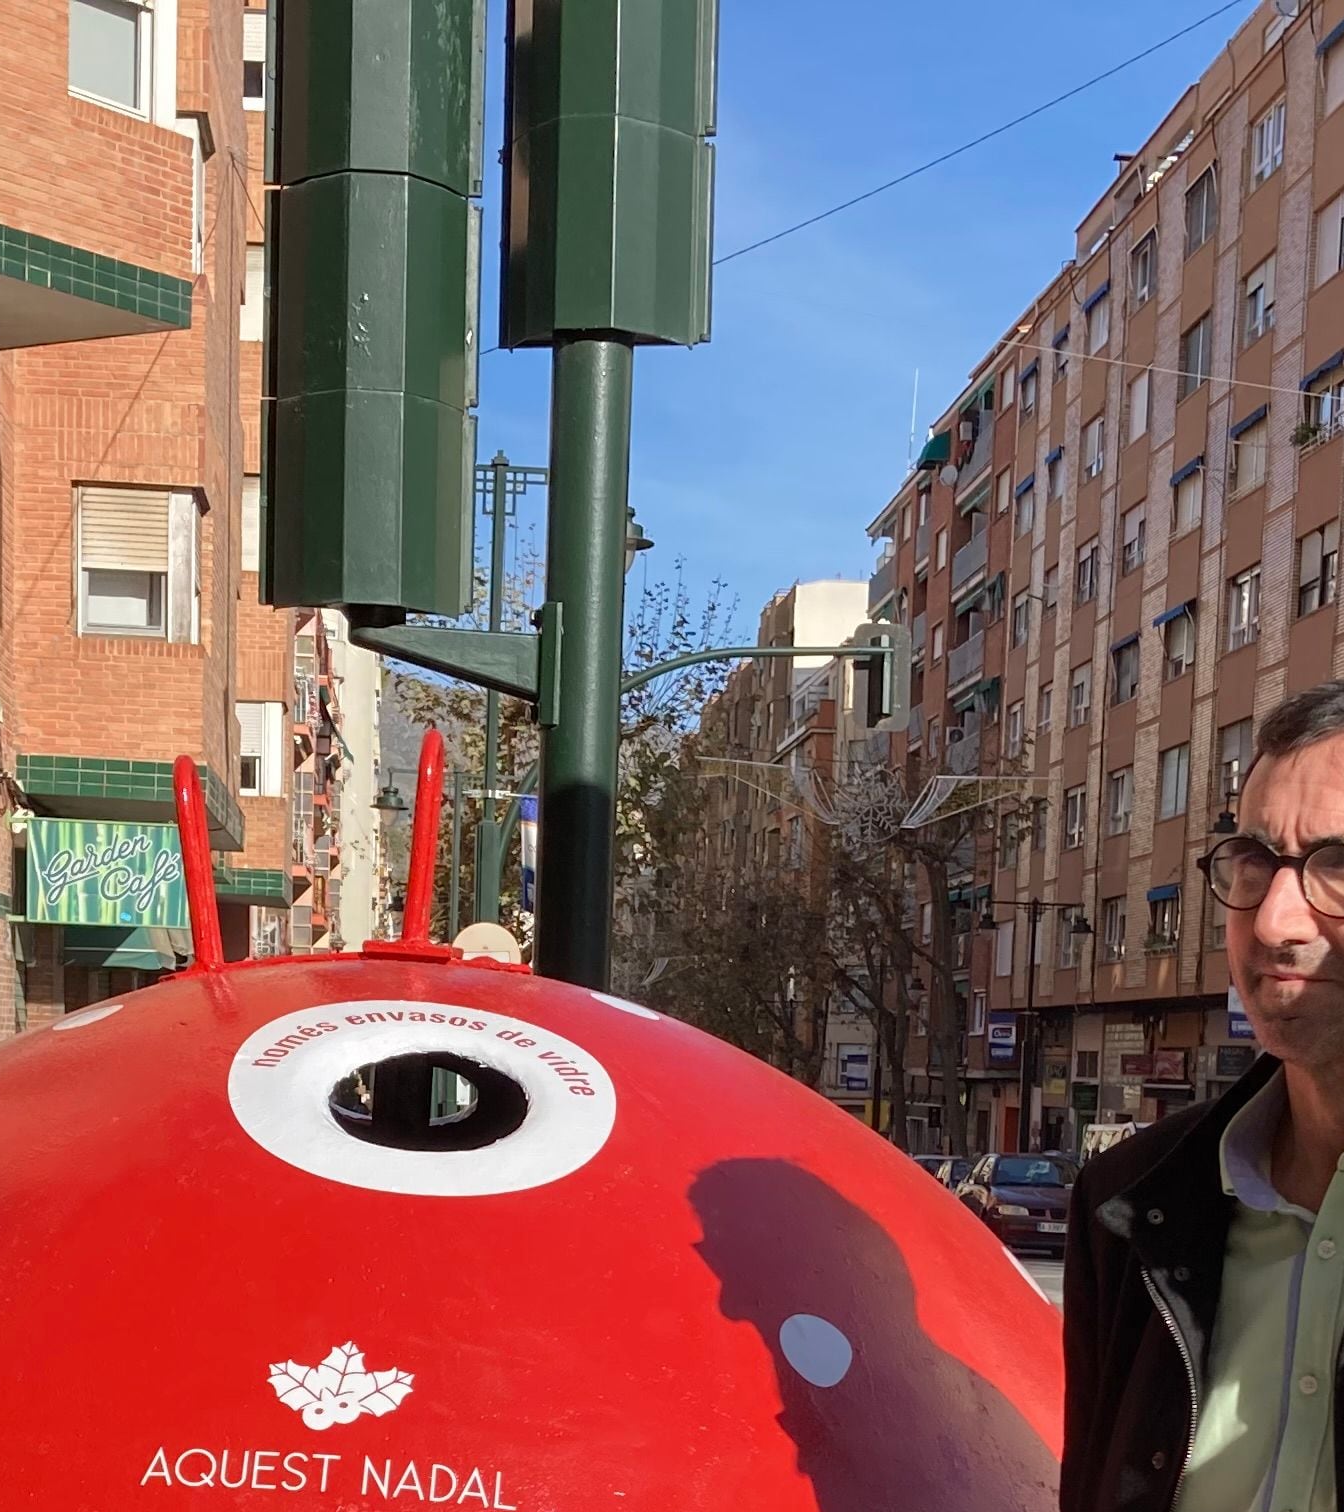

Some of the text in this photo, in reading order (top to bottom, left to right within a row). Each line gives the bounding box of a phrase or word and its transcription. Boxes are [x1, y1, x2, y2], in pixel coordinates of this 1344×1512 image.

[43, 833, 152, 905] Garden
[100, 848, 181, 914] Café
[252, 1009, 596, 1097] només envasos de vidre
[139, 1446, 517, 1511] AQUEST NADAL
